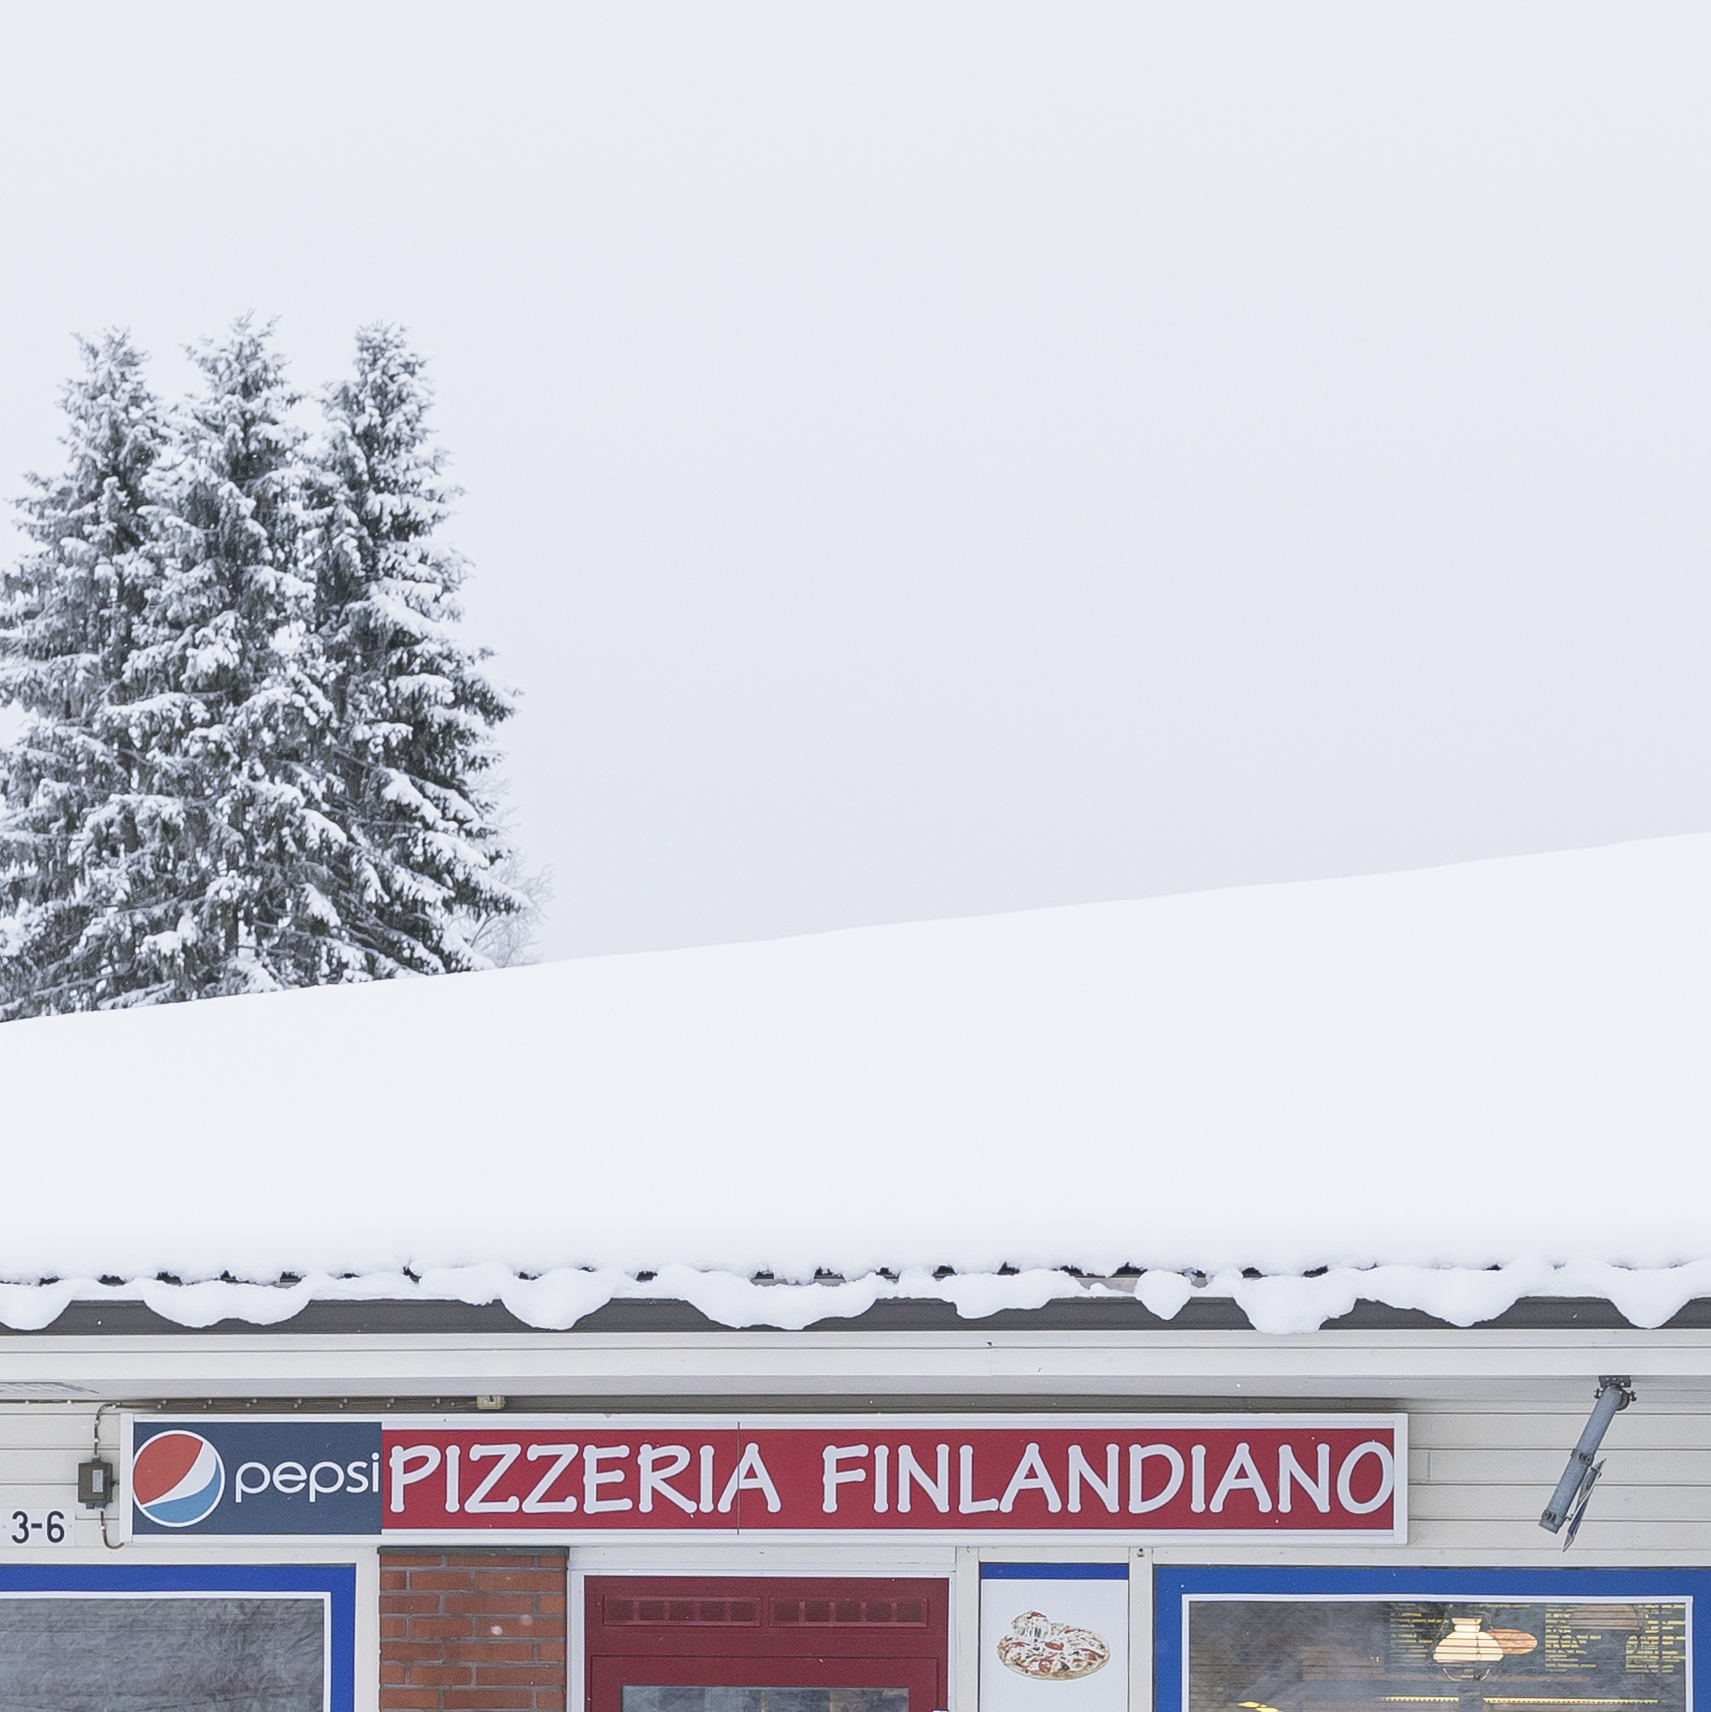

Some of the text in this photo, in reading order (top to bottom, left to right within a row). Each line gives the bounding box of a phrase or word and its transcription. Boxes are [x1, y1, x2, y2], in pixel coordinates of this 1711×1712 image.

[236, 1452, 379, 1503] pepsi
[389, 1441, 1394, 1515] PIZZERIA FINLANDIANO
[11, 1510, 66, 1544] 3-6
